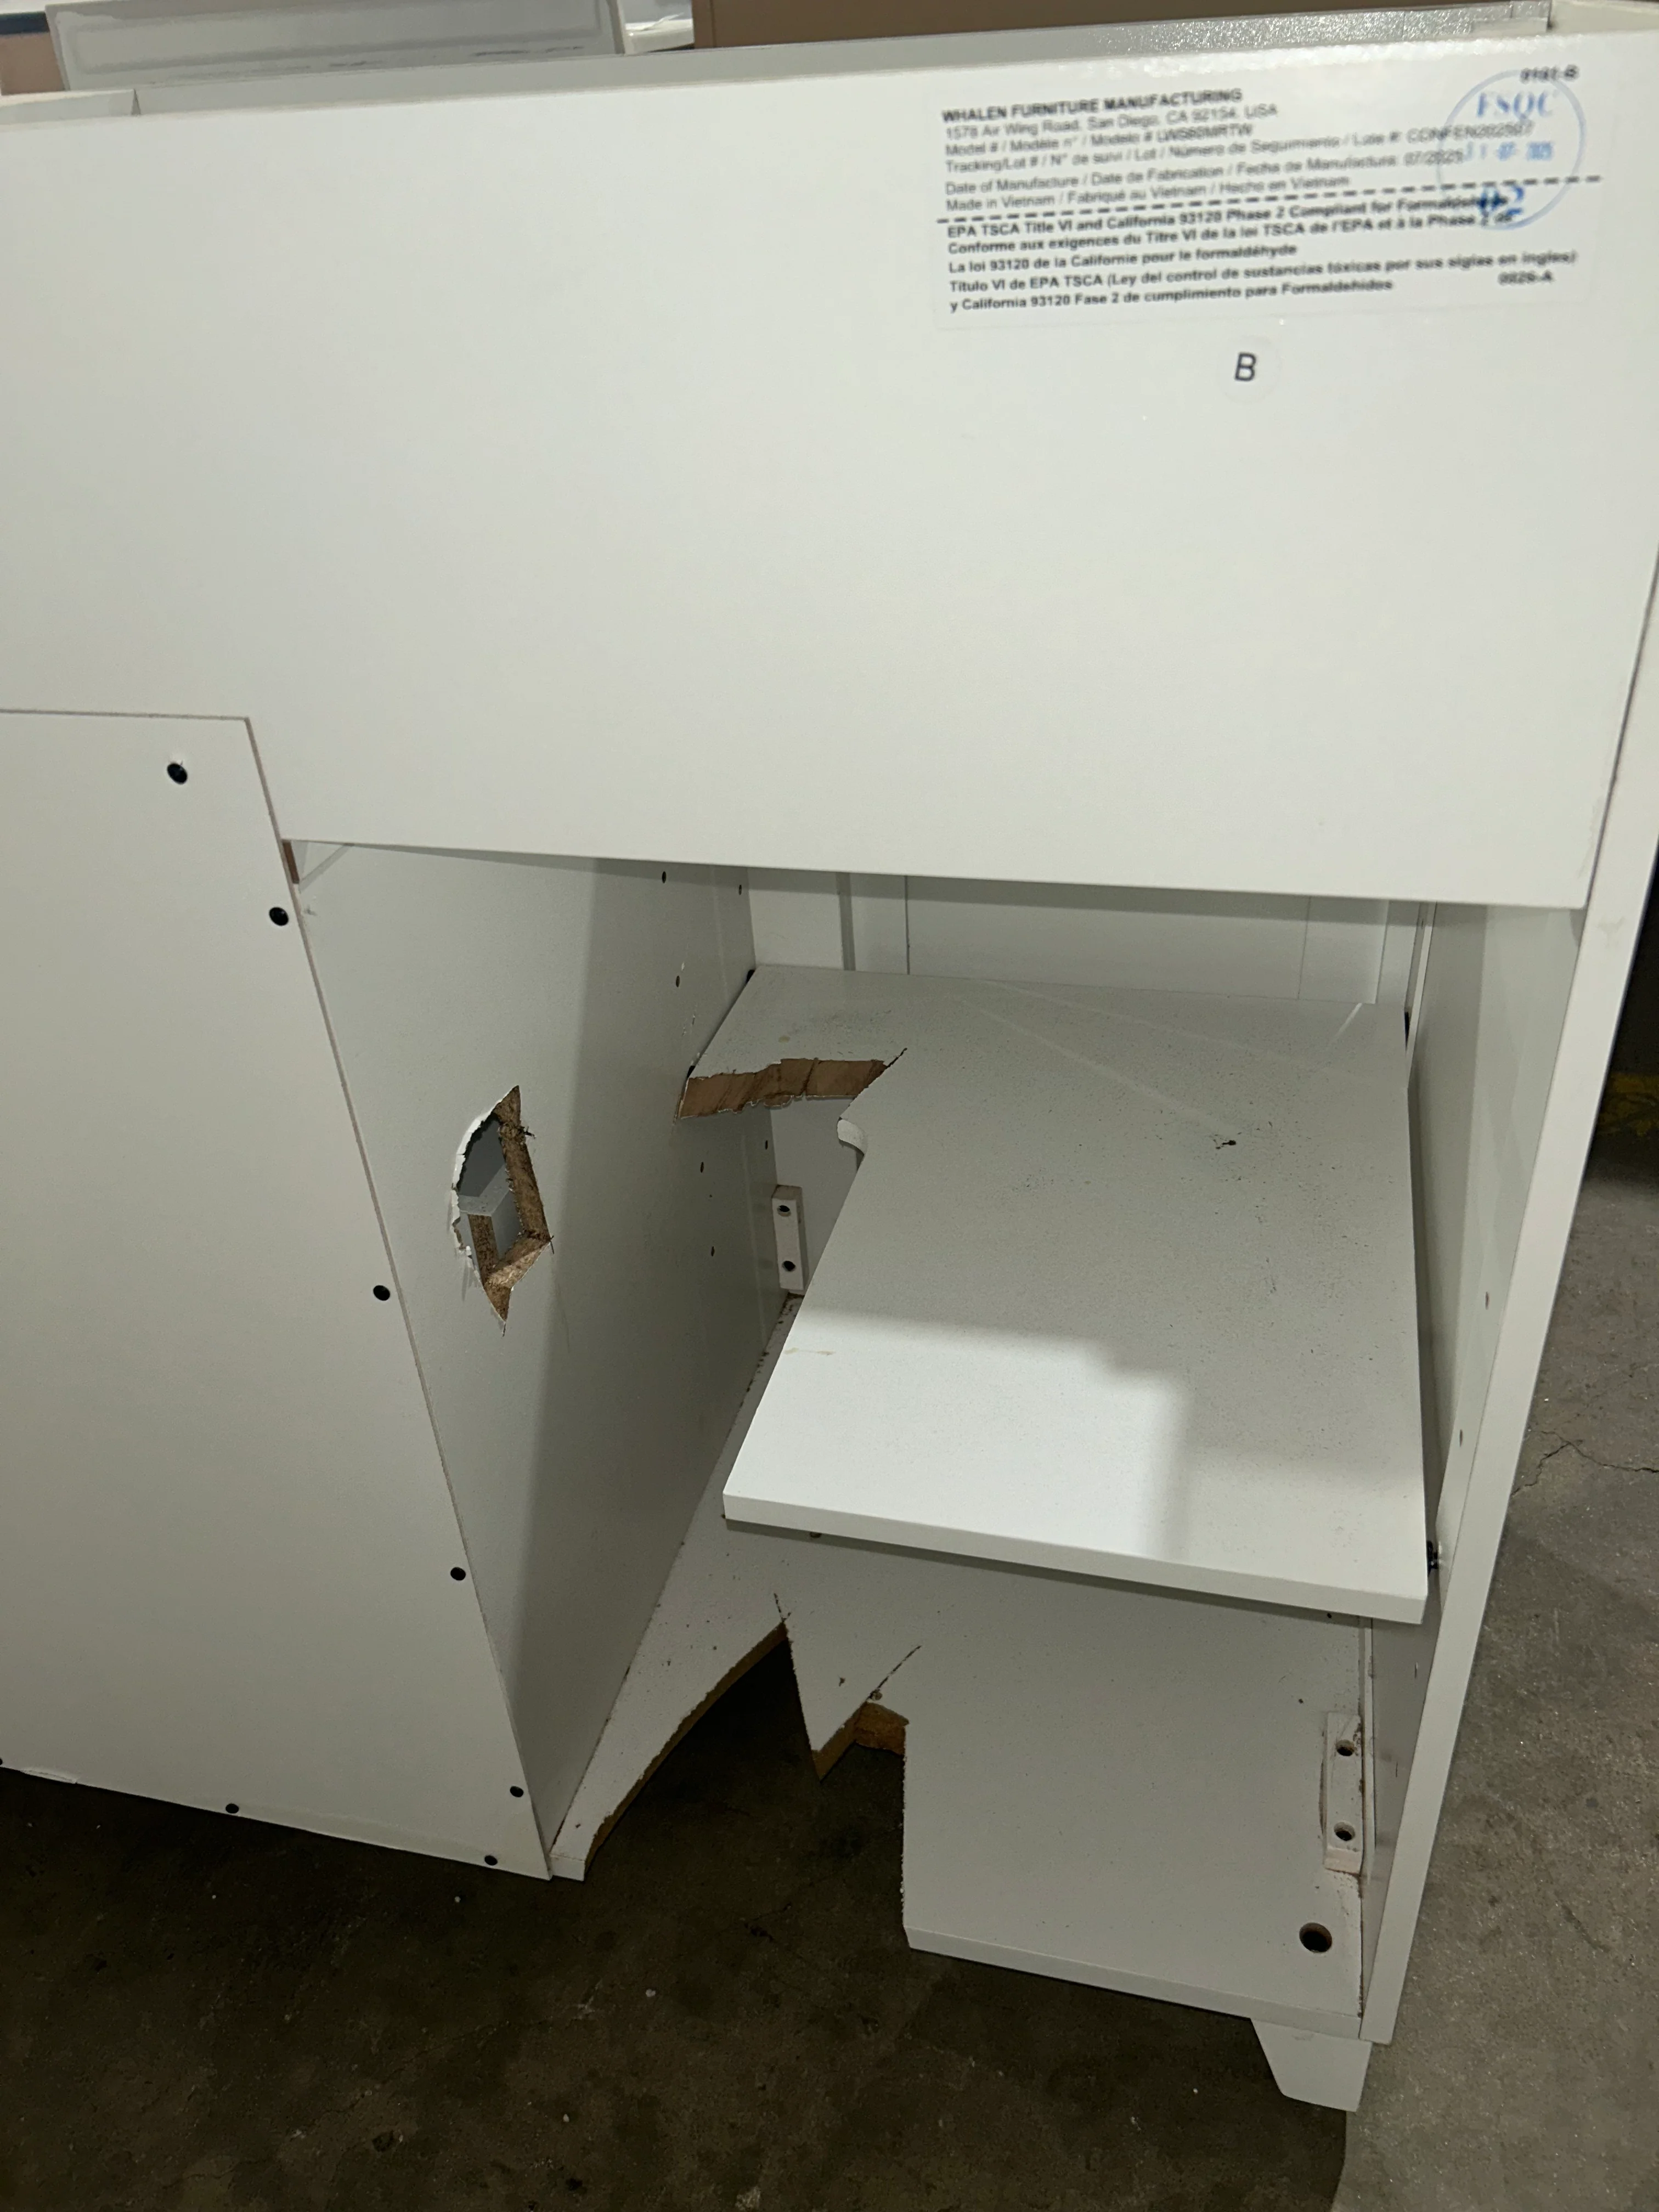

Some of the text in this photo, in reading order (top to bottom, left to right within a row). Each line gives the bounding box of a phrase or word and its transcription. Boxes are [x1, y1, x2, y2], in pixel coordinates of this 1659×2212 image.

[942, 88, 1242, 122] WHALEN FURNITURE MANUFACTURING
[981, 123, 1000, 136] Air
[1004, 122, 1039, 136] Wing
[1087, 116, 1114, 131] San
[1165, 110, 1188, 125] CA
[1244, 104, 1278, 120] USA
[945, 142, 986, 156] Model
[1072, 154, 1089, 165] de
[1227, 143, 1246, 155] de
[945, 181, 977, 195] Date
[980, 179, 992, 193] of
[997, 176, 1079, 191] Manufacture
[1092, 172, 1122, 186] Date
[1127, 171, 1143, 183] de
[1147, 167, 1224, 181] Fabrication
[1237, 161, 1280, 176] Fecha
[1285, 161, 1302, 173] de
[946, 198, 982, 211] Made
[986, 198, 997, 209] in
[1001, 194, 1055, 208] Vietnam
[1129, 189, 1147, 200] au
[1150, 185, 1206, 199] Vietnam
[1219, 181, 1265, 194] Hecho
[1267, 180, 1286, 191] en
[1290, 176, 1350, 190] Vietnam
[947, 225, 977, 239] EPA
[981, 223, 1020, 236] TSCA
[1024, 221, 1054, 234] Title
[1057, 219, 1073, 232] VI
[1076, 218, 1103, 232] and
[1107, 215, 1175, 230] California
[1179, 211, 1222, 224] 93120
[1226, 207, 1272, 221] Phase
[1275, 205, 1285, 219] 2
[1289, 202, 1367, 218] Compliant
[1370, 199, 1393, 213] for
[947, 240, 1015, 255] Conforme
[1019, 239, 1044, 251] aux
[1048, 235, 1119, 251] exigences
[1123, 232, 1141, 245] du
[1146, 229, 1178, 244] Titre
[1181, 228, 1197, 241] VI
[1200, 227, 1218, 240] de
[1222, 225, 1236, 239] la
[1239, 225, 1259, 238] loi
[1263, 221, 1305, 236] TSCA
[1309, 219, 1328, 234] de
[1378, 217, 1392, 230] et
[1409, 215, 1423, 228] la
[1427, 213, 1475, 227] Phase
[948, 261, 966, 273] La
[969, 259, 986, 272] loi
[990, 257, 1029, 272] 93120
[1033, 255, 1050, 269] de
[1054, 255, 1067, 267] la
[1071, 252, 1138, 267] Californie
[1141, 252, 1176, 266] pour
[1178, 249, 1192, 261] le
[992, 278, 1006, 290] VI
[1009, 278, 1026, 291] de
[1030, 276, 1059, 289] EPA
[1064, 274, 1103, 287] TSCA
[1107, 272, 1137, 288] (Ley
[1141, 270, 1163, 284] del
[1166, 268, 1217, 283] control
[1221, 267, 1239, 280] de
[1244, 263, 1324, 278] sustancias
[1384, 259, 1412, 273] por
[1415, 257, 1443, 270] sus
[1497, 253, 1518, 267] en
[950, 301, 958, 314] y
[961, 296, 1027, 311] California
[1030, 294, 1070, 308] 93120
[1074, 292, 1107, 306] Fase
[1111, 290, 1120, 304] 2
[1123, 290, 1141, 303] de
[1144, 286, 1242, 303] cumplimiento
[1245, 284, 1278, 300] para
[1234, 352, 1256, 381] B
